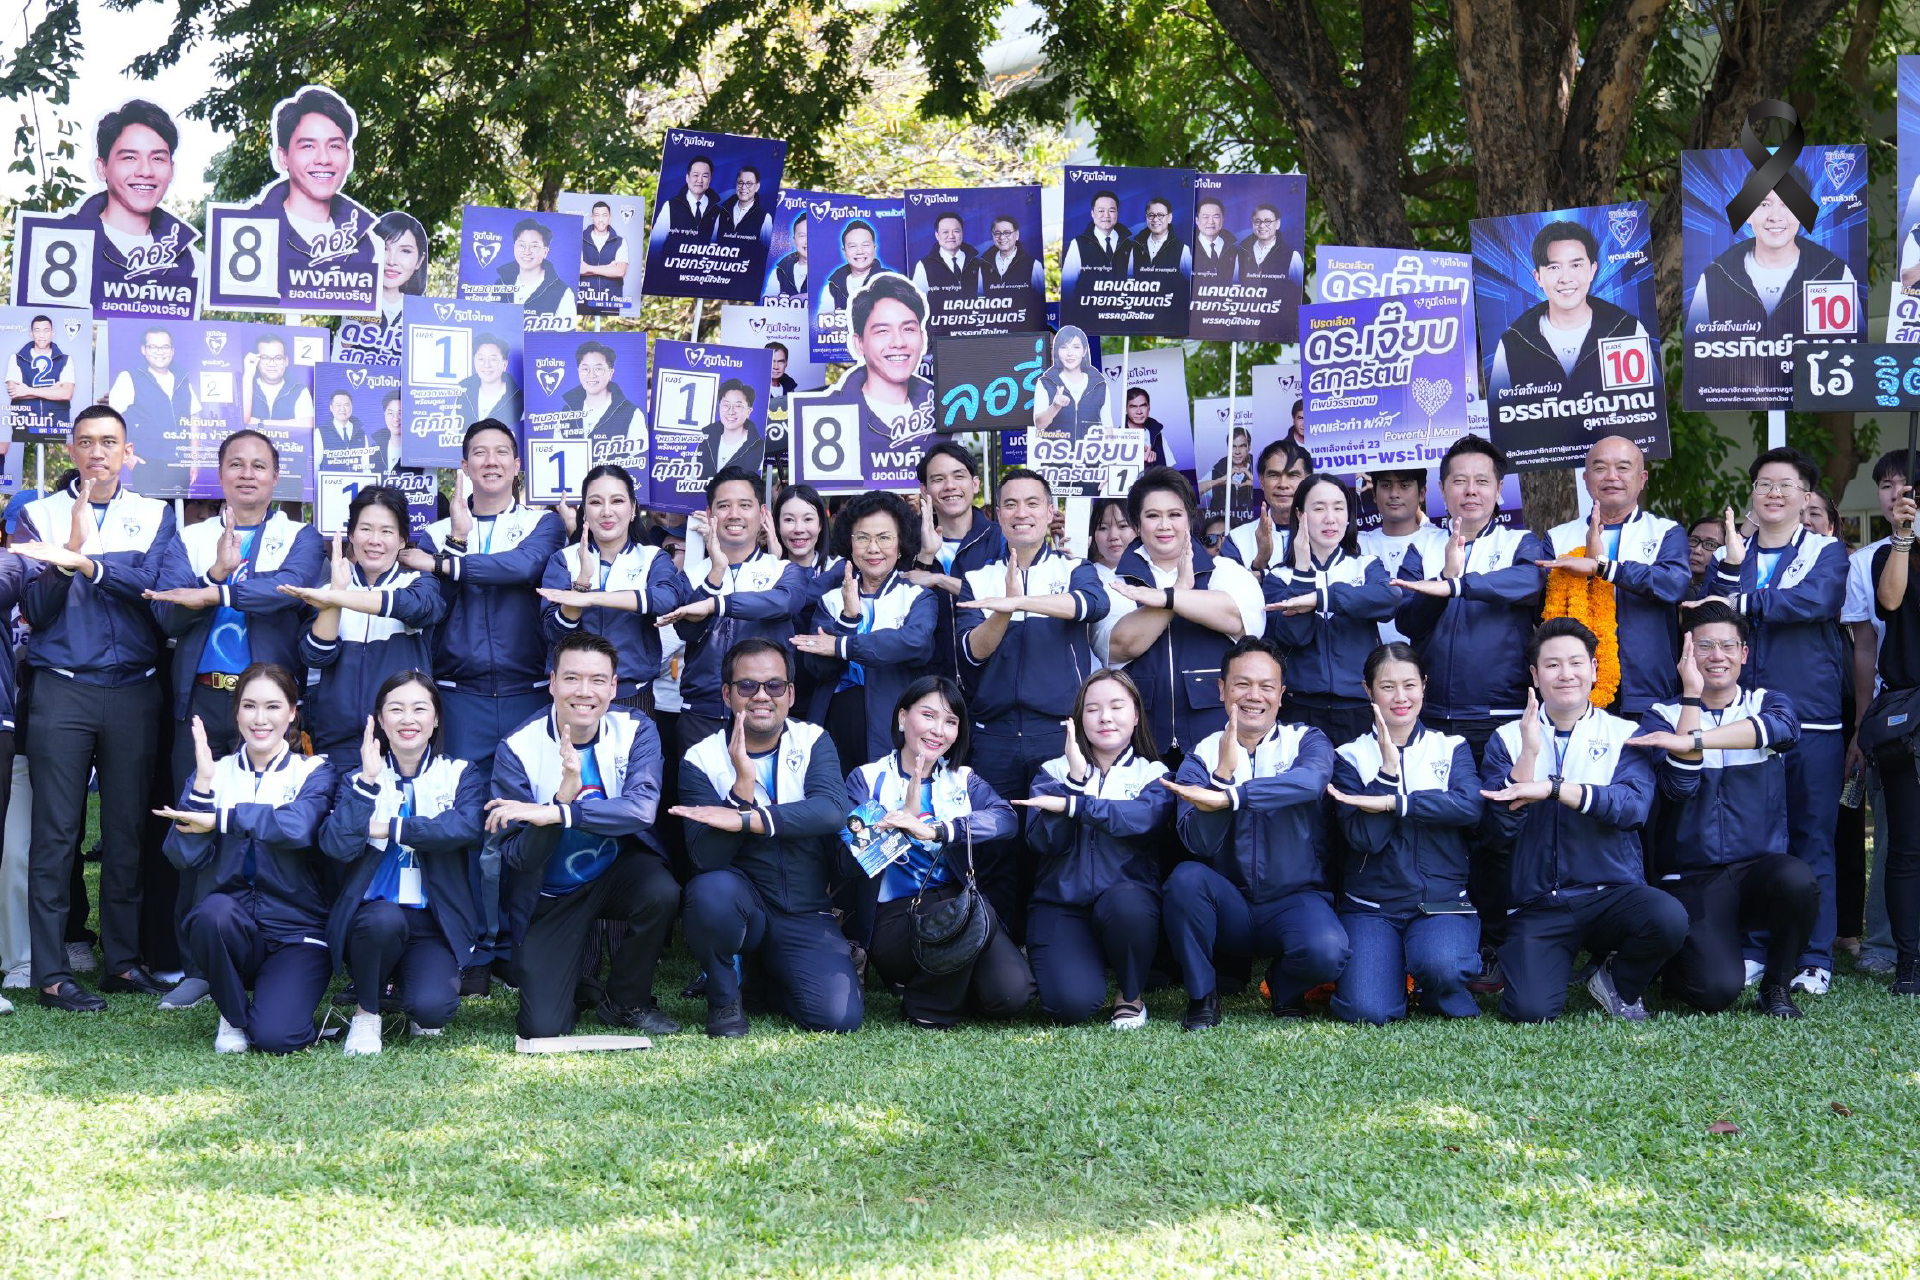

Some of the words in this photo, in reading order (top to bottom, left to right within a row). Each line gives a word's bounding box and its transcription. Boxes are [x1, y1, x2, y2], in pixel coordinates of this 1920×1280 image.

[683, 137, 714, 147] ภูมิใจไทย
[1082, 172, 1116, 183] ภูมิใจไทย
[924, 194, 958, 206] ภูมิใจไทย
[1820, 194, 1857, 205] พูดแล้วทำ
[830, 206, 870, 220] ภูมิใจไทย
[310, 209, 358, 258] ลอรี่
[473, 232, 502, 241] ภูมิใจไทย
[126, 223, 179, 271] ลอรี่
[229, 226, 261, 282] 8
[679, 243, 740, 258] แคนดิเดต
[664, 257, 750, 273] นายกรัฐมนตรี
[1328, 259, 1374, 270] โปรดเลือก
[1440, 258, 1468, 268] ภูมิใจไทย
[1608, 250, 1644, 265] พูดแล้วทำ
[41, 241, 77, 297] 8
[289, 266, 373, 288] พงศ์พล
[680, 274, 730, 285] พรรคภูมิใจไทย
[1094, 278, 1160, 292] แคนดิเดต
[103, 280, 192, 302] พงศ์พล
[289, 289, 372, 303] ยอดเมืองเจริญ
[1198, 284, 1267, 297] แคนดิเดต
[1810, 286, 1828, 294] เบอร์
[102, 301, 190, 317] ยอดเมืองเจริญ
[943, 297, 1012, 310] แคนดิเดต
[1080, 293, 1173, 309] นายกรัฐมนตรี
[455, 310, 493, 322] ภูมิใจไทย
[931, 309, 1026, 326] นายกรัฐมนตรี
[1098, 310, 1154, 321] พรรคภูมิใจไทย
[1310, 316, 1355, 329] โปรดเลือก
[1425, 296, 1457, 309] ภูมิใจไทย
[1812, 295, 1851, 330] 10
[767, 323, 800, 333] ภูมิใจไทย
[1202, 316, 1261, 327] พรรคภูมิใจไทย
[1305, 302, 1458, 365] ดร.เจี๊ยบ
[301, 345, 313, 359] 2
[435, 335, 457, 378] 1
[536, 358, 565, 367] ภูมิใจไทย
[703, 354, 743, 367] ภูมิใจไทย
[1607, 349, 1644, 384] 10
[30, 355, 55, 387] 2
[1310, 357, 1412, 401] สกุลรัตน์
[207, 380, 221, 396] 2
[677, 382, 699, 426] 1
[1311, 395, 1378, 411] ทิพย์วรรณงาม
[411, 413, 464, 437] ศุภิกา
[533, 422, 570, 432] พร้อมดูแล
[1310, 418, 1361, 435] พูดแล้วทำ
[1584, 411, 1657, 430] คูหาเรืองรอง
[1036, 429, 1071, 438] โปรดเลือก
[1434, 427, 1461, 436] Mom
[593, 434, 645, 457] ศุภิกา
[812, 417, 844, 472] 8
[1034, 425, 1139, 462] ดร.เจี๊ยบ
[1311, 439, 1364, 453] เขตเลือกตั้งที่
[1368, 440, 1380, 449] 23
[1647, 436, 1655, 444] 33
[548, 450, 572, 493] 1
[652, 455, 703, 482] ศุภิกา
[1116, 470, 1127, 492] 1
